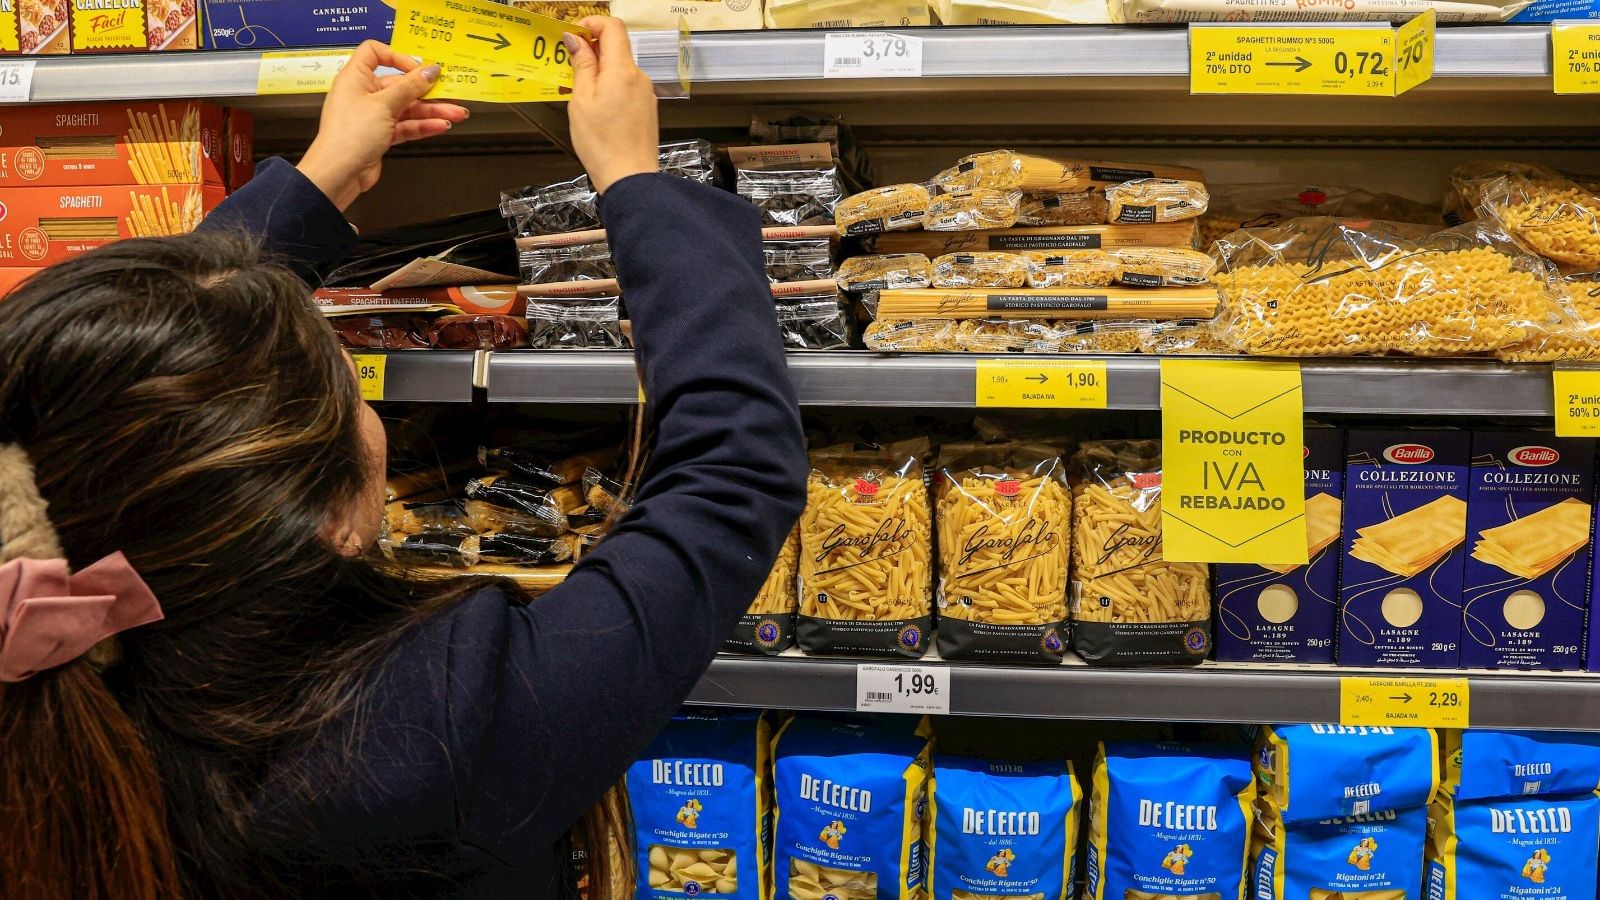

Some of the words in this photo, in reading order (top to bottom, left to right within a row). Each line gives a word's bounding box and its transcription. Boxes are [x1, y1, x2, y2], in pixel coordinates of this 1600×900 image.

[313, 7, 368, 15] CANNELLONI
[423, 13, 455, 29] unidad
[408, 24, 428, 38] 70%
[430, 29, 453, 42] DTO
[1236, 36, 1277, 44] SPAGHETTI
[1277, 36, 1304, 44] RUMMO
[1218, 51, 1252, 61] unidad
[1206, 64, 1227, 74] 70%
[1229, 64, 1252, 74] DTO
[1569, 62, 1590, 73] 70%
[56, 113, 99, 127] SPAGHETTI
[60, 196, 102, 208] SPAGHETTI
[766, 231, 805, 239] LINGUINE
[1569, 407, 1590, 417] 50%
[1179, 429, 1286, 446] PRODUCTO
[1222, 449, 1242, 457] CON
[1395, 448, 1430, 459] Barilla
[1520, 450, 1555, 461] Barilla
[1203, 461, 1266, 492] IVA
[1359, 470, 1456, 482] COLLEZIONE
[1483, 472, 1581, 485] COLLEZIONE
[1180, 495, 1286, 511] REBAJADO
[815, 517, 917, 563] Garofalo
[958, 518, 1061, 566] Garofalo
[1306, 638, 1318, 647] 250
[1431, 642, 1443, 651] 250
[1552, 645, 1564, 653] 250
[652, 759, 672, 785] DE
[674, 760, 724, 787] CECCO
[1514, 764, 1526, 777] DE
[1526, 762, 1551, 776] CECCO
[799, 773, 820, 802] DE
[822, 779, 872, 813] CECCO
[1355, 783, 1381, 797] CECCO
[842, 812, 855, 820] 1831
[962, 807, 985, 835] DE
[987, 809, 1040, 836] CECCO
[1138, 799, 1163, 828] DE
[1165, 801, 1218, 831] CECCO
[1489, 807, 1517, 834] DE
[1515, 807, 1572, 834] CECCO
[654, 828, 688, 839] Conchiglie
[688, 831, 712, 841] Rigate
[795, 842, 830, 857] Conchiglie
[830, 851, 854, 862] Rigate
[960, 874, 998, 886] Conchiglie
[998, 879, 1023, 888] Rigate
[1133, 873, 1173, 885] Conchiglie
[1174, 878, 1199, 887] Rigate
[1336, 873, 1370, 882] Rigatoni
[1509, 886, 1545, 895] Rigatoni
